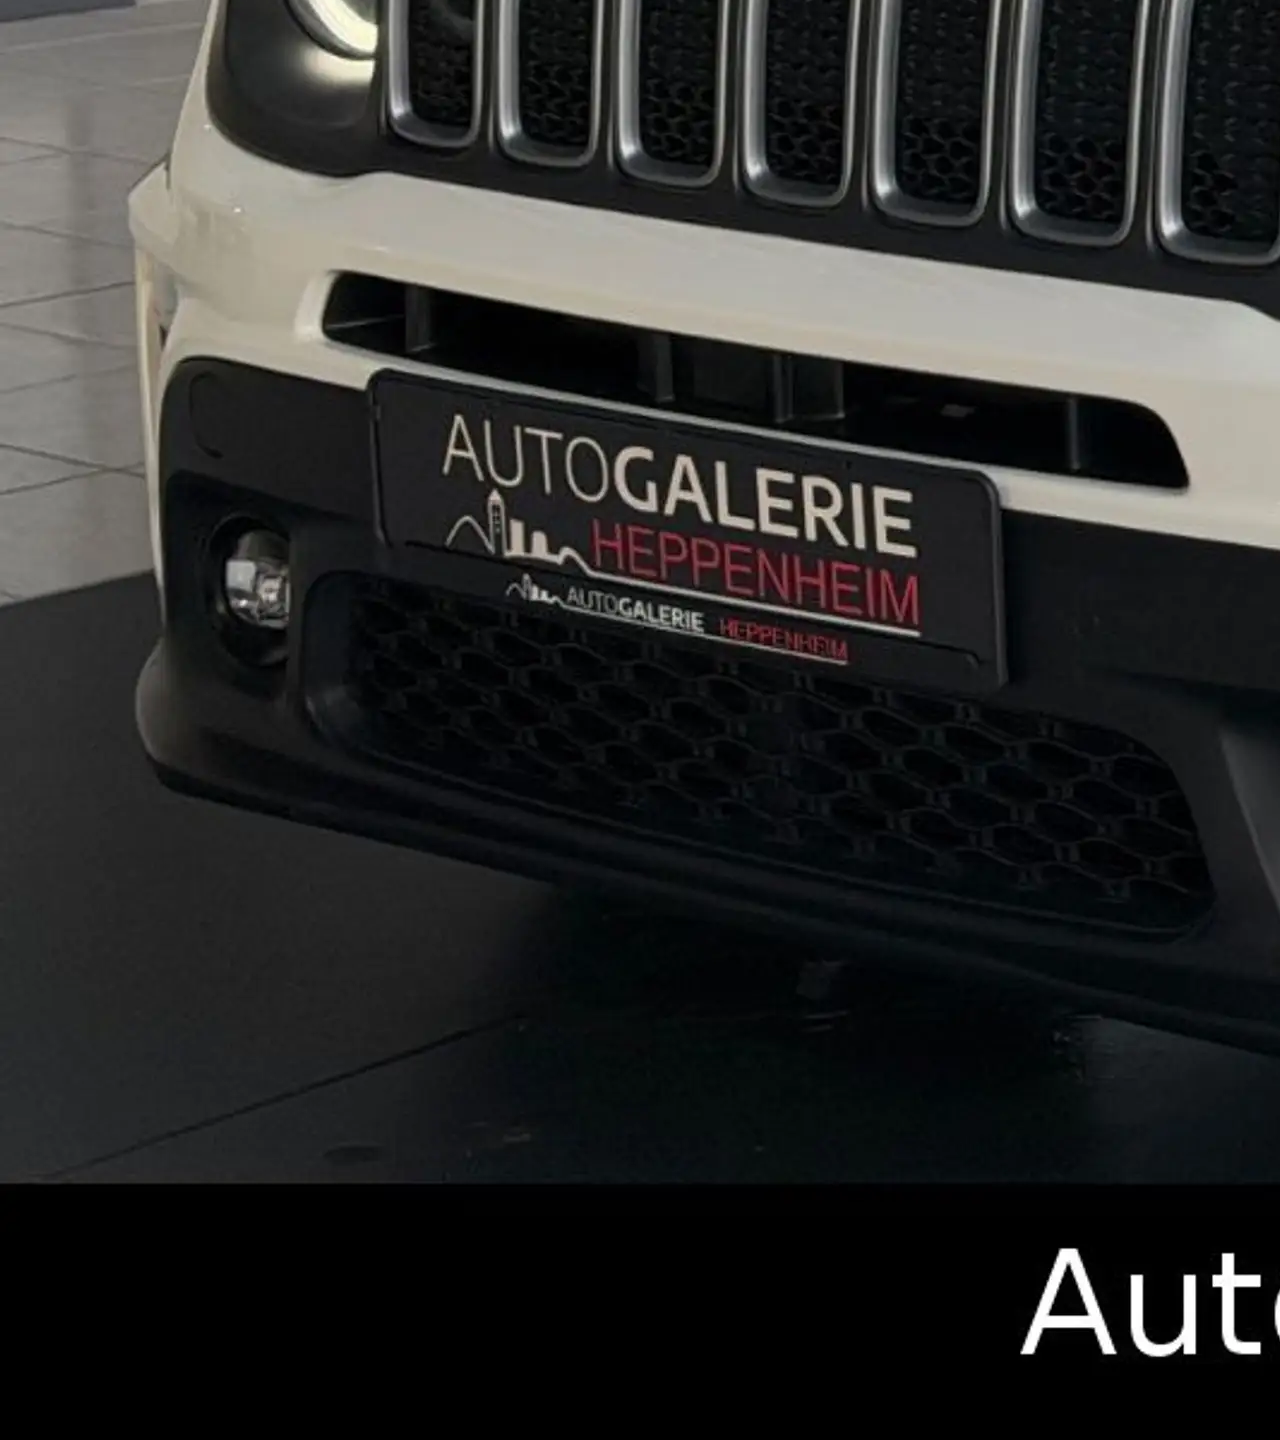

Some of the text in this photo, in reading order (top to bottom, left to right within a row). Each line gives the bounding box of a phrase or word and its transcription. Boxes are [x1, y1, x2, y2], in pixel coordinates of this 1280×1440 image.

[442, 413, 917, 558] AUTOGALERIE
[567, 586, 848, 658] AUTOGALERIE HEPPENHEIM
[588, 518, 921, 626] HEPPENHEIM
